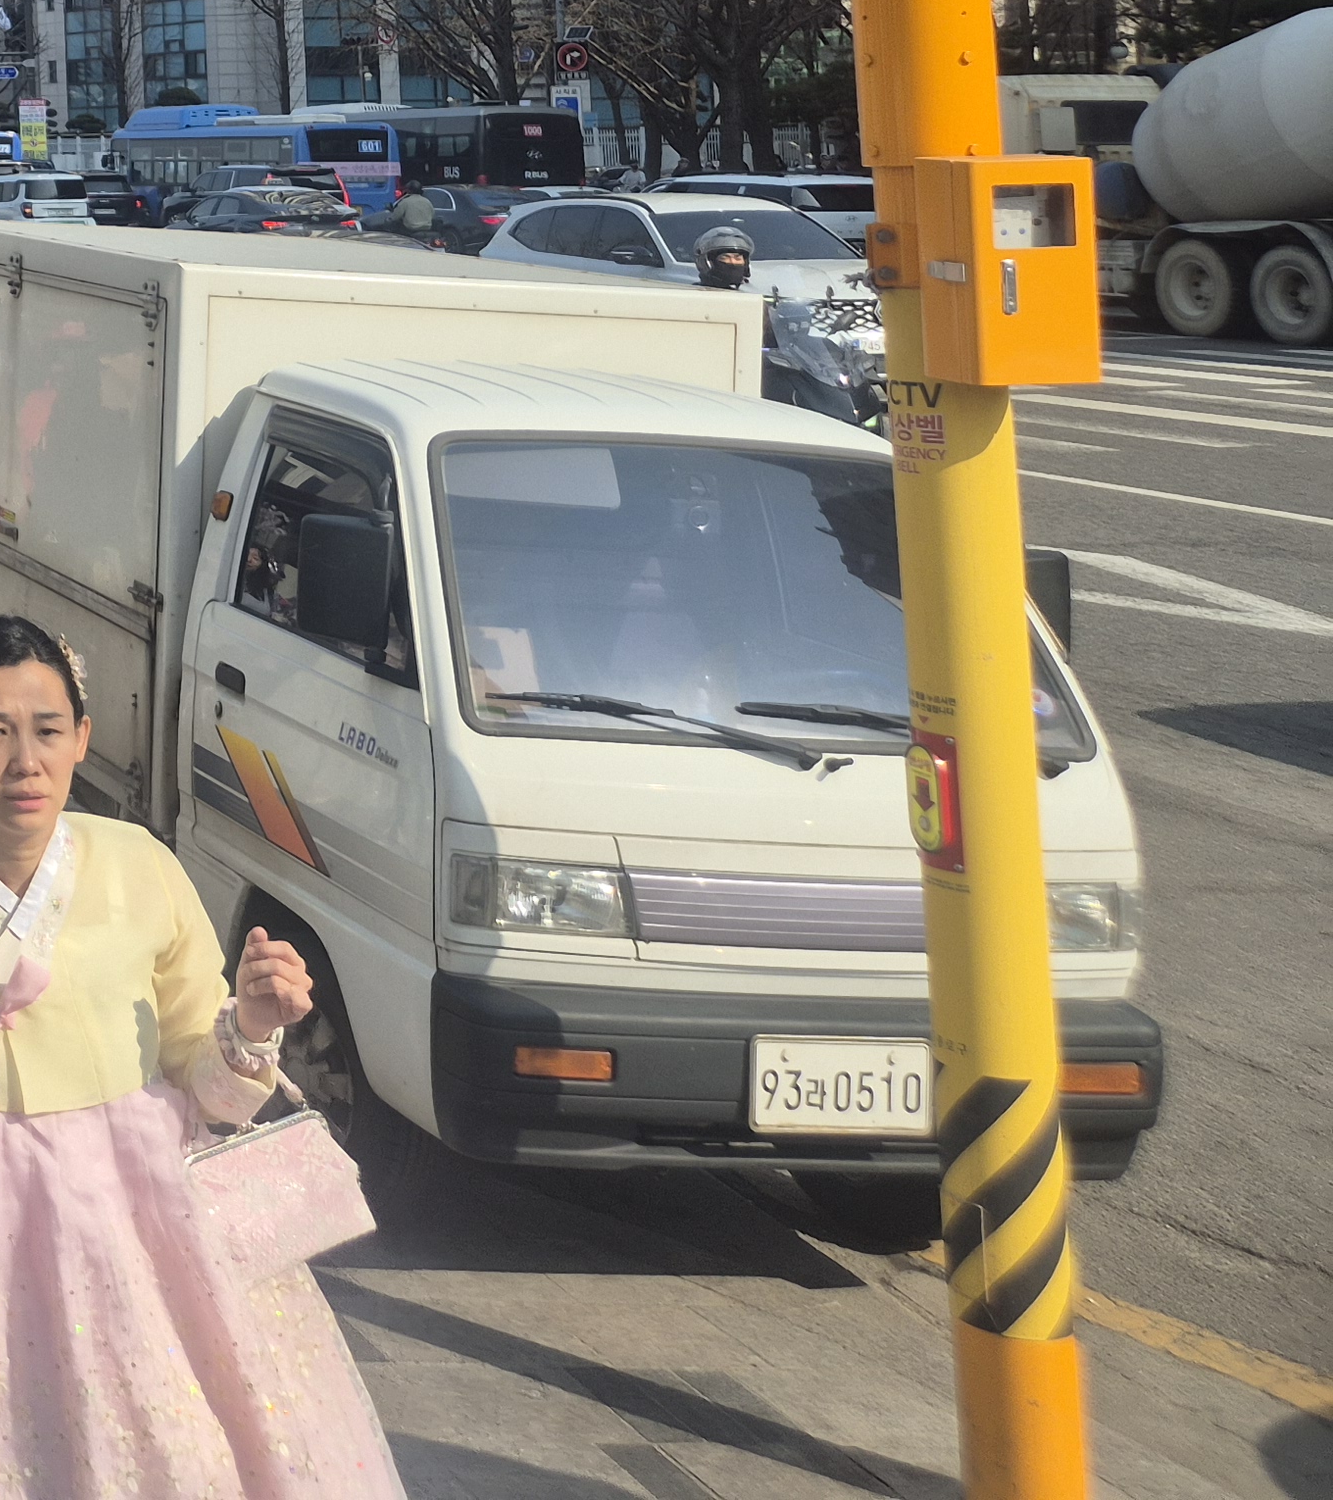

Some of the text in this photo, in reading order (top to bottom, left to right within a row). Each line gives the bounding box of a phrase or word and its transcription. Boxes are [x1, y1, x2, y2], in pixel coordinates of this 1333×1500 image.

[361, 140, 380, 151] 601
[443, 166, 461, 179] BUS
[886, 379, 943, 408] CTV
[890, 412, 946, 445] 상벨
[337, 720, 377, 757] LABO
[761, 1068, 922, 1114] 93라0510
